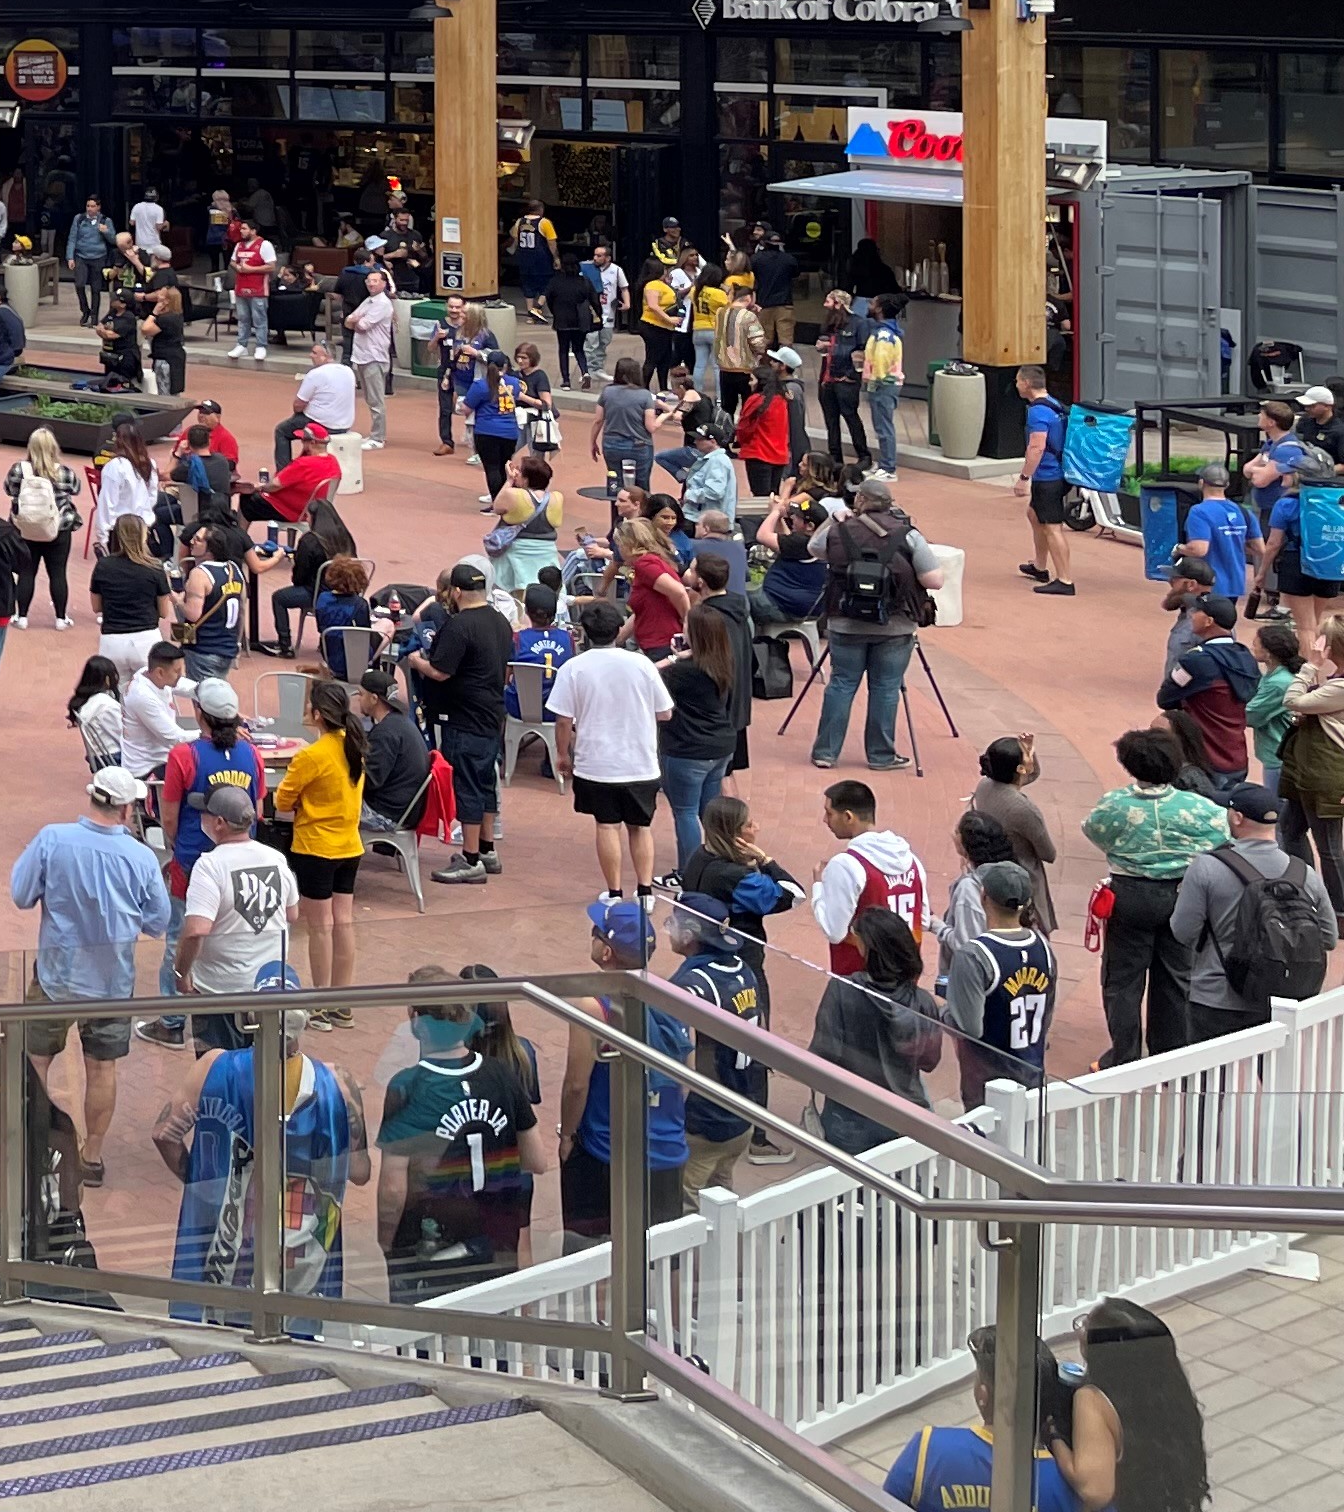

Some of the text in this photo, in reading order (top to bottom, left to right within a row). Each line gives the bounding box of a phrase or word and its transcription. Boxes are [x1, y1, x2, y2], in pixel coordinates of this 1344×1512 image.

[888, 119, 964, 163] Coo
[520, 232, 535, 248] 50
[530, 639, 555, 654] PORTER
[544, 652, 553, 679] 1
[208, 770, 252, 790] GORDON
[887, 893, 916, 928] 15
[1003, 966, 1049, 997] MURRAY
[1010, 993, 1046, 1050] 27
[435, 1099, 489, 1141] PORTER
[466, 1132, 486, 1193] 1
